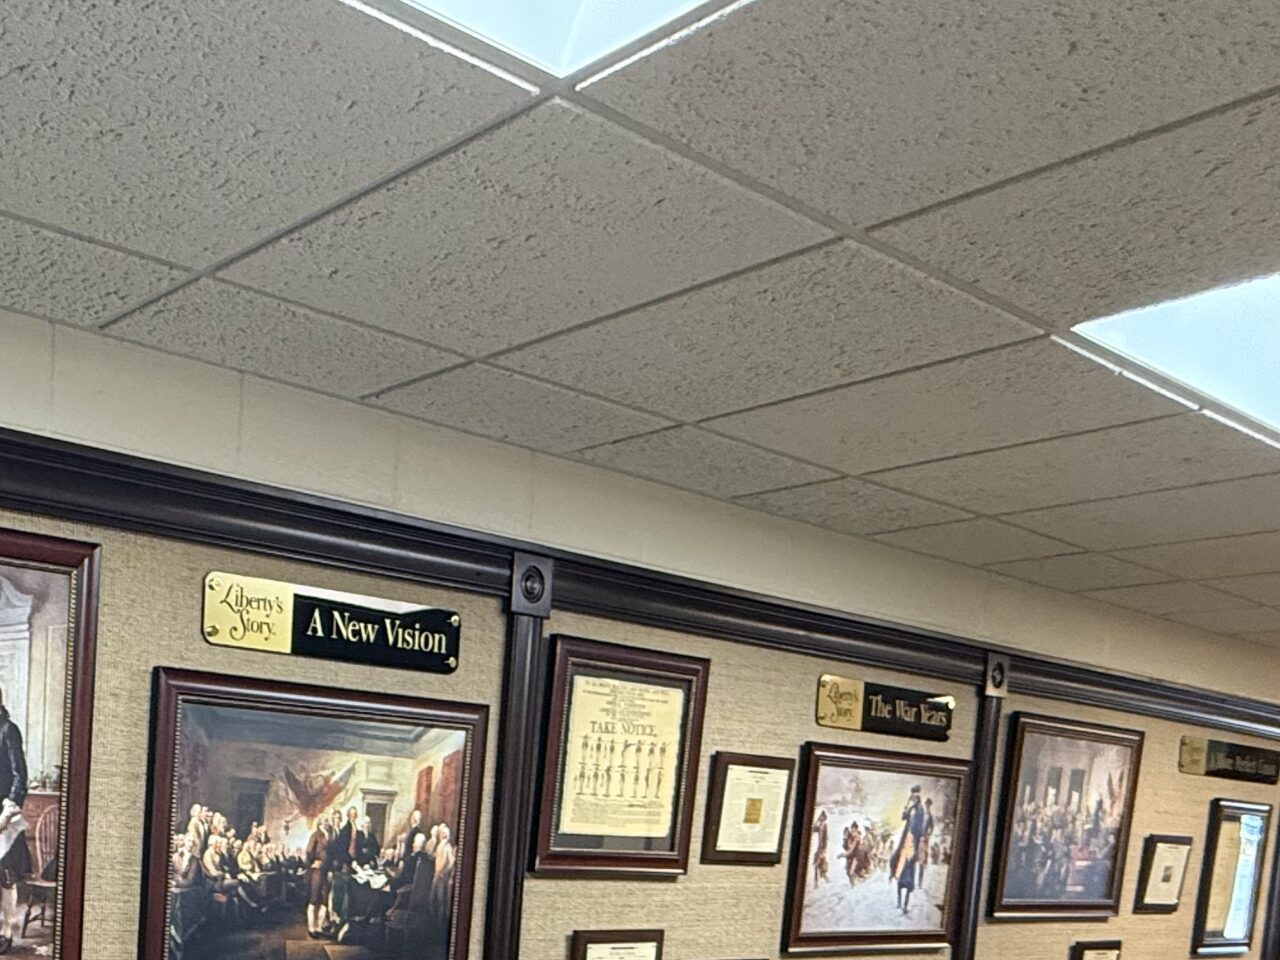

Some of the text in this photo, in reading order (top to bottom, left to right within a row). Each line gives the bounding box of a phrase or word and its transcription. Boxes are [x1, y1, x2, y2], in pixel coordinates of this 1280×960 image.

[219, 583, 283, 620] Liberty's
[230, 607, 275, 642] Story
[306, 607, 448, 654] A New Vision
[590, 721, 617, 734] TAKE
[868, 693, 948, 727] The War Years
